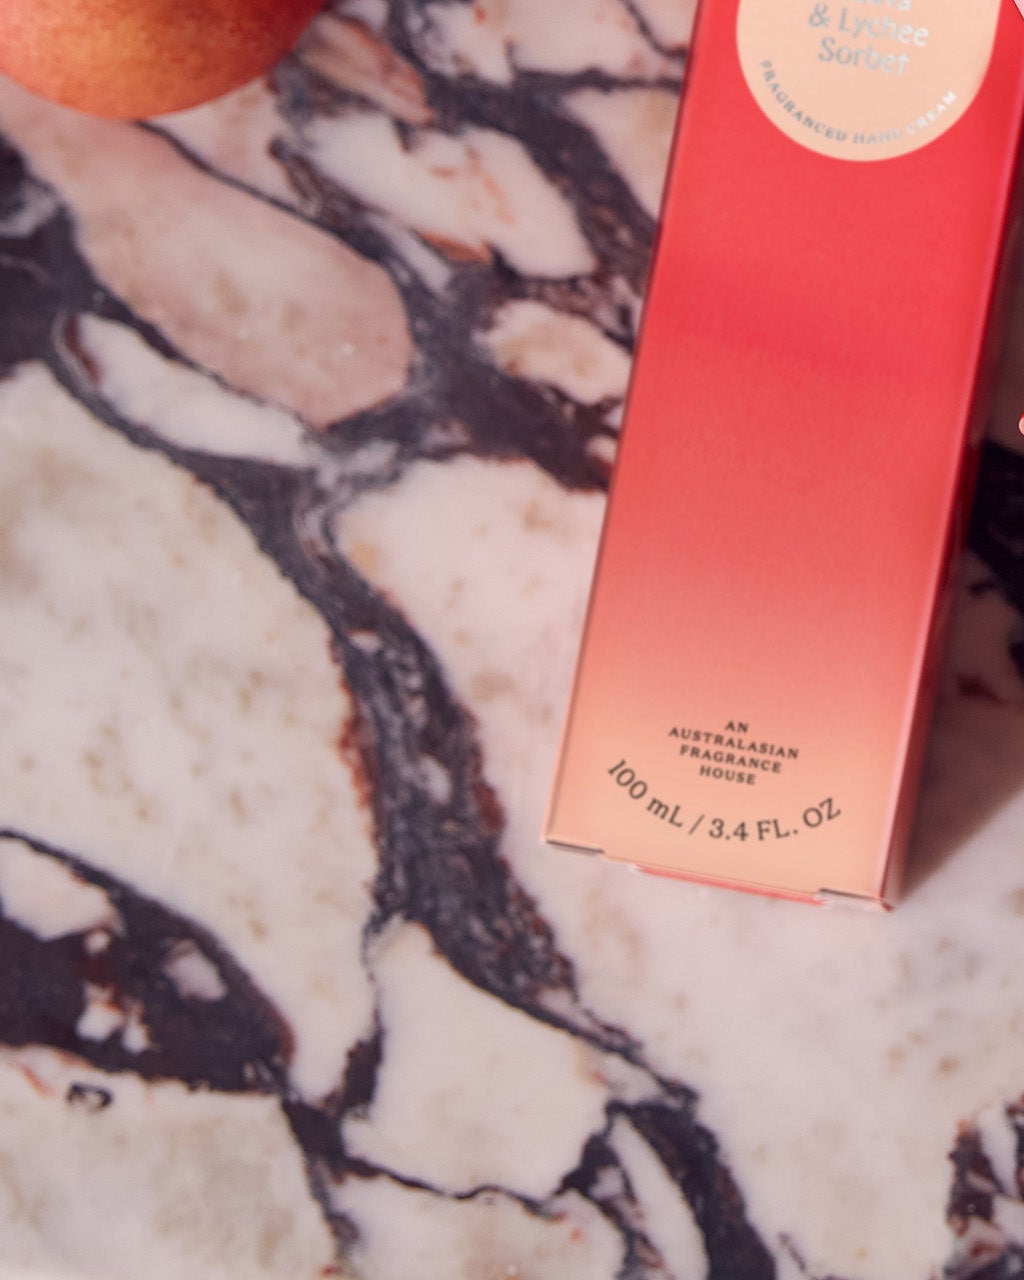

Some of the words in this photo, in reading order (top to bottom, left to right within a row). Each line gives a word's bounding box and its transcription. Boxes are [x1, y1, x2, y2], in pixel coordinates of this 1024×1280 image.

[808, 2, 830, 29] &
[838, 7, 929, 47] Lychee
[818, 36, 909, 76] Sorbet
[759, 59, 848, 142] FRAGRANCED
[852, 127, 902, 144] HAND
[906, 90, 957, 134] CREAM
[668, 726, 800, 760] AUSTRALASIAN
[725, 720, 749, 733] AN
[679, 744, 782, 774] FRAGRANCE
[698, 764, 756, 786] HOUSE
[607, 759, 649, 801] 100
[646, 797, 685, 828] mL
[688, 814, 706, 836] /
[708, 818, 750, 842] 3.4
[756, 818, 799, 842] FL.
[802, 796, 842, 829] OZ
